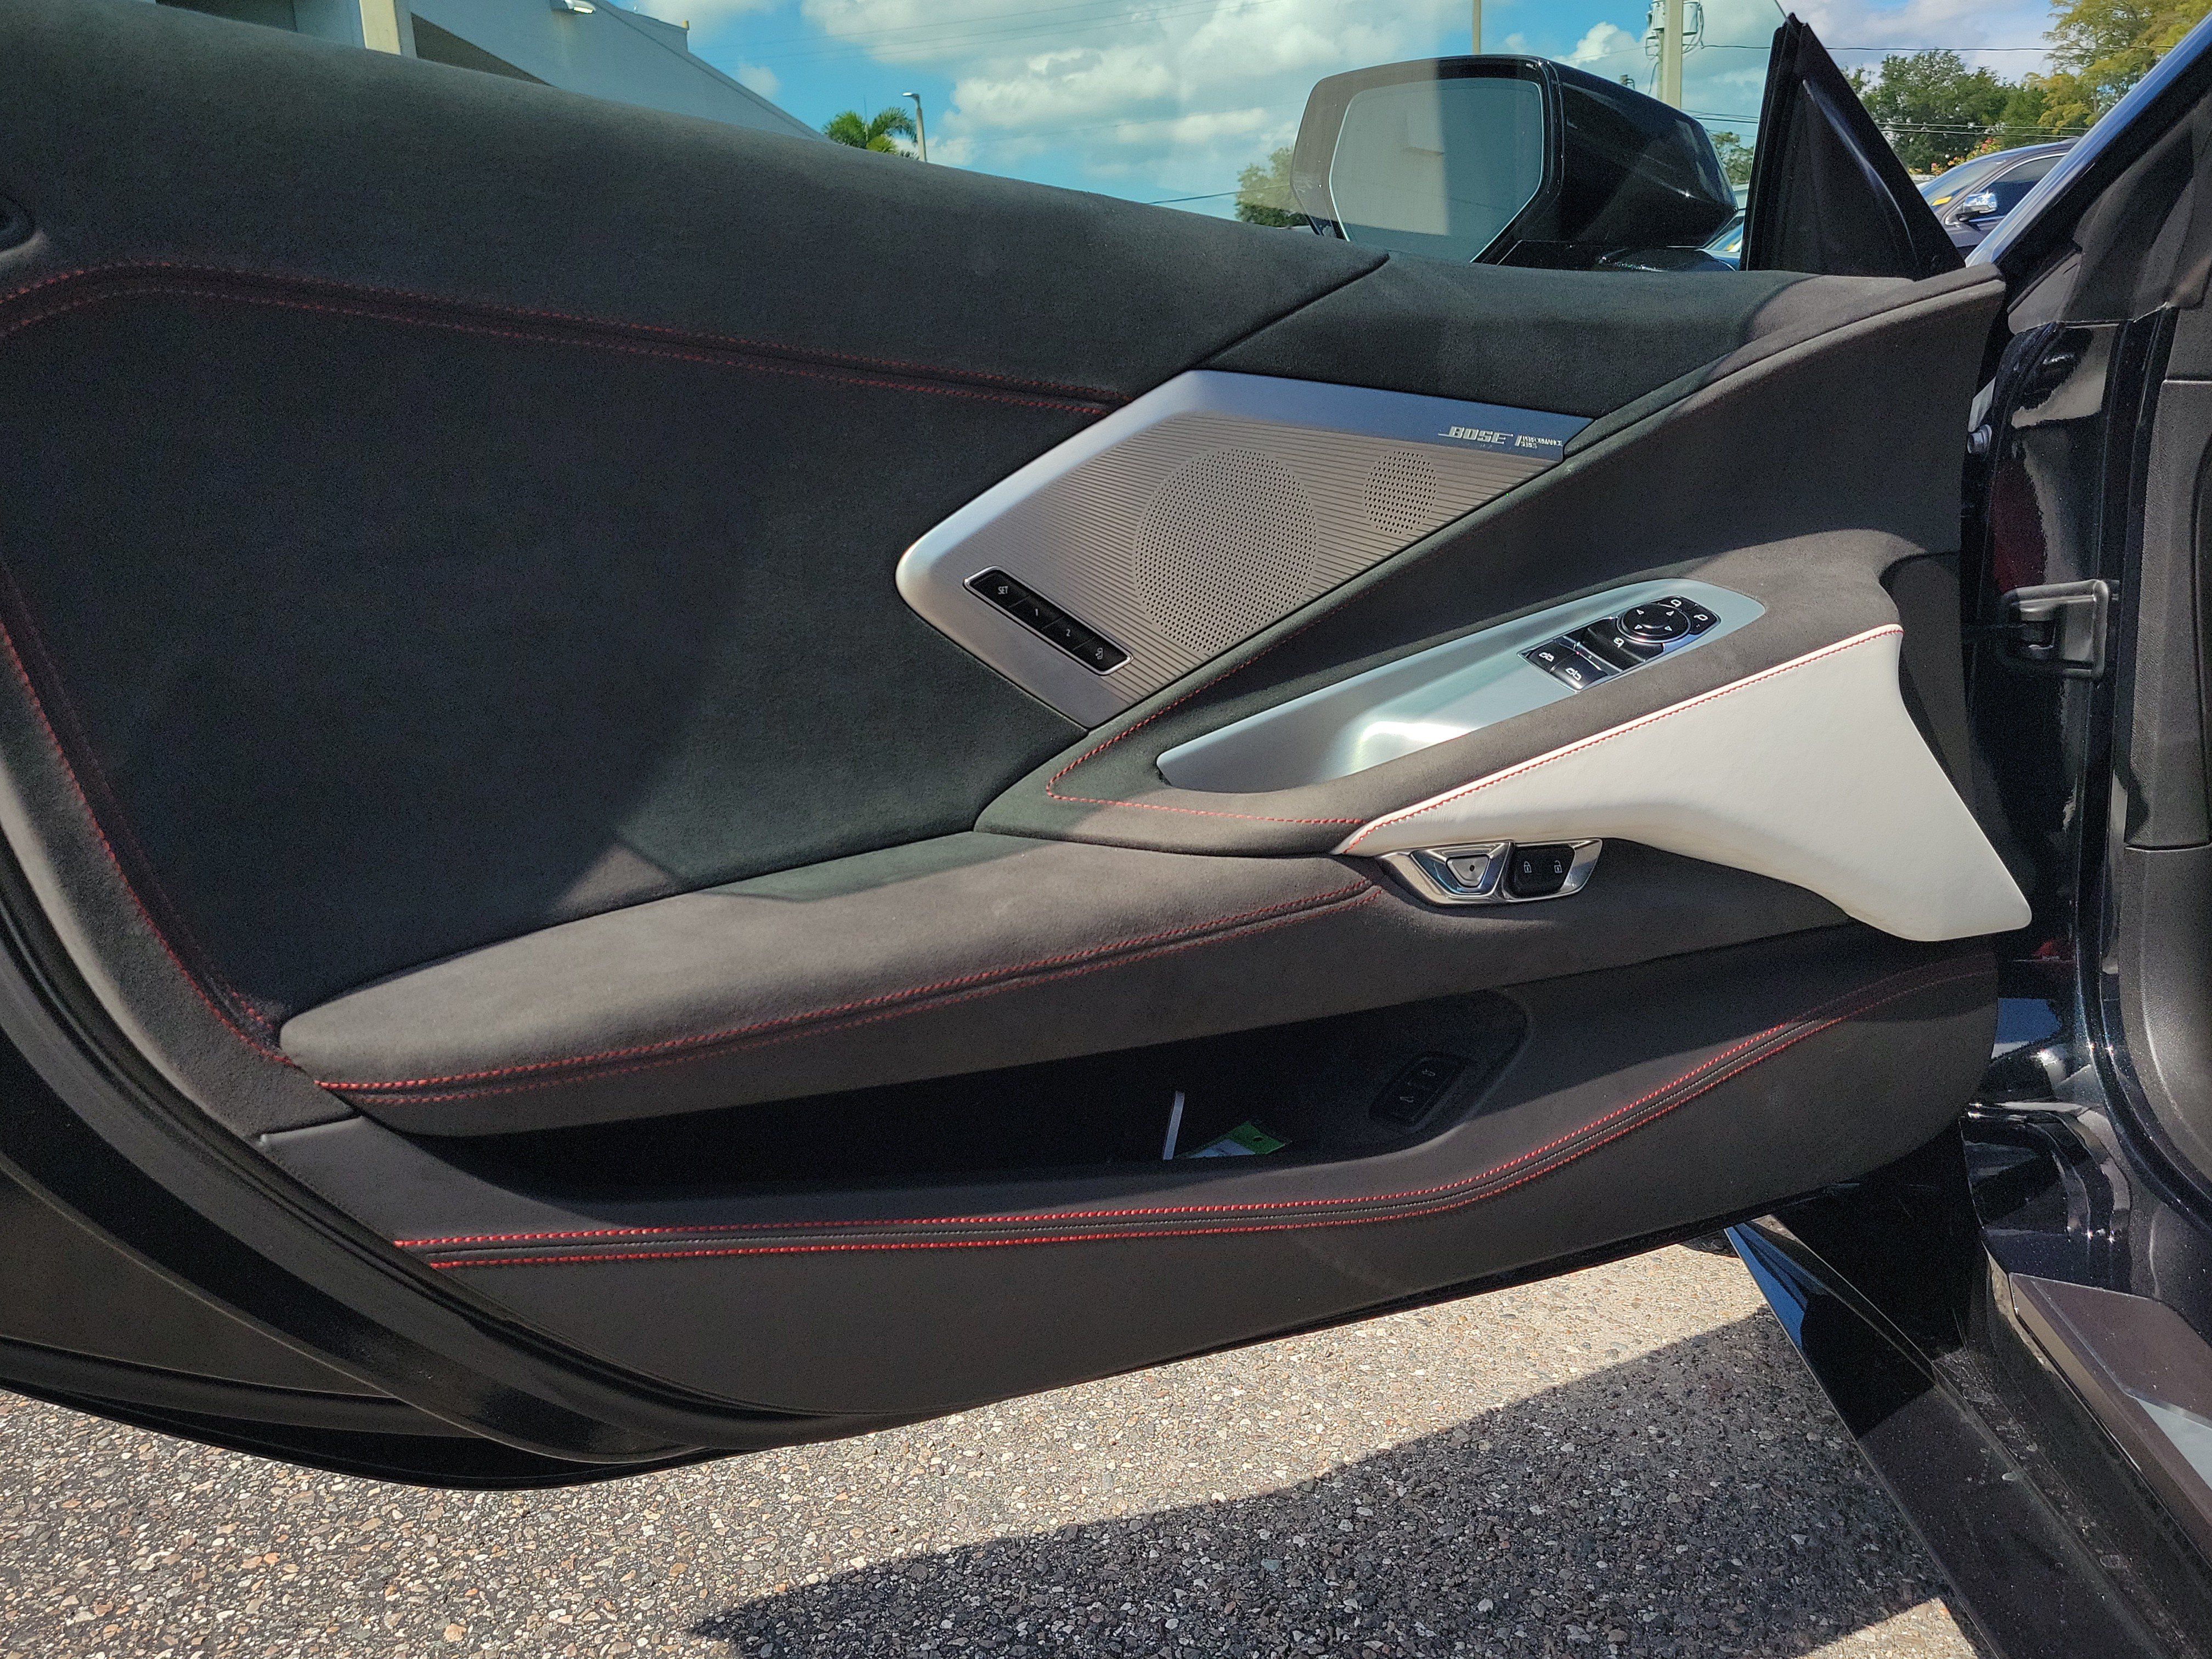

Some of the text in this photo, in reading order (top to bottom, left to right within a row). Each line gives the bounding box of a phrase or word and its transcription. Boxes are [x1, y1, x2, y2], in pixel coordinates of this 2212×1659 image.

[1438, 426, 1514, 445] BOSE
[998, 585, 1009, 595] SET
[1035, 608, 1039, 617] 1
[1065, 629, 1071, 637] 2
